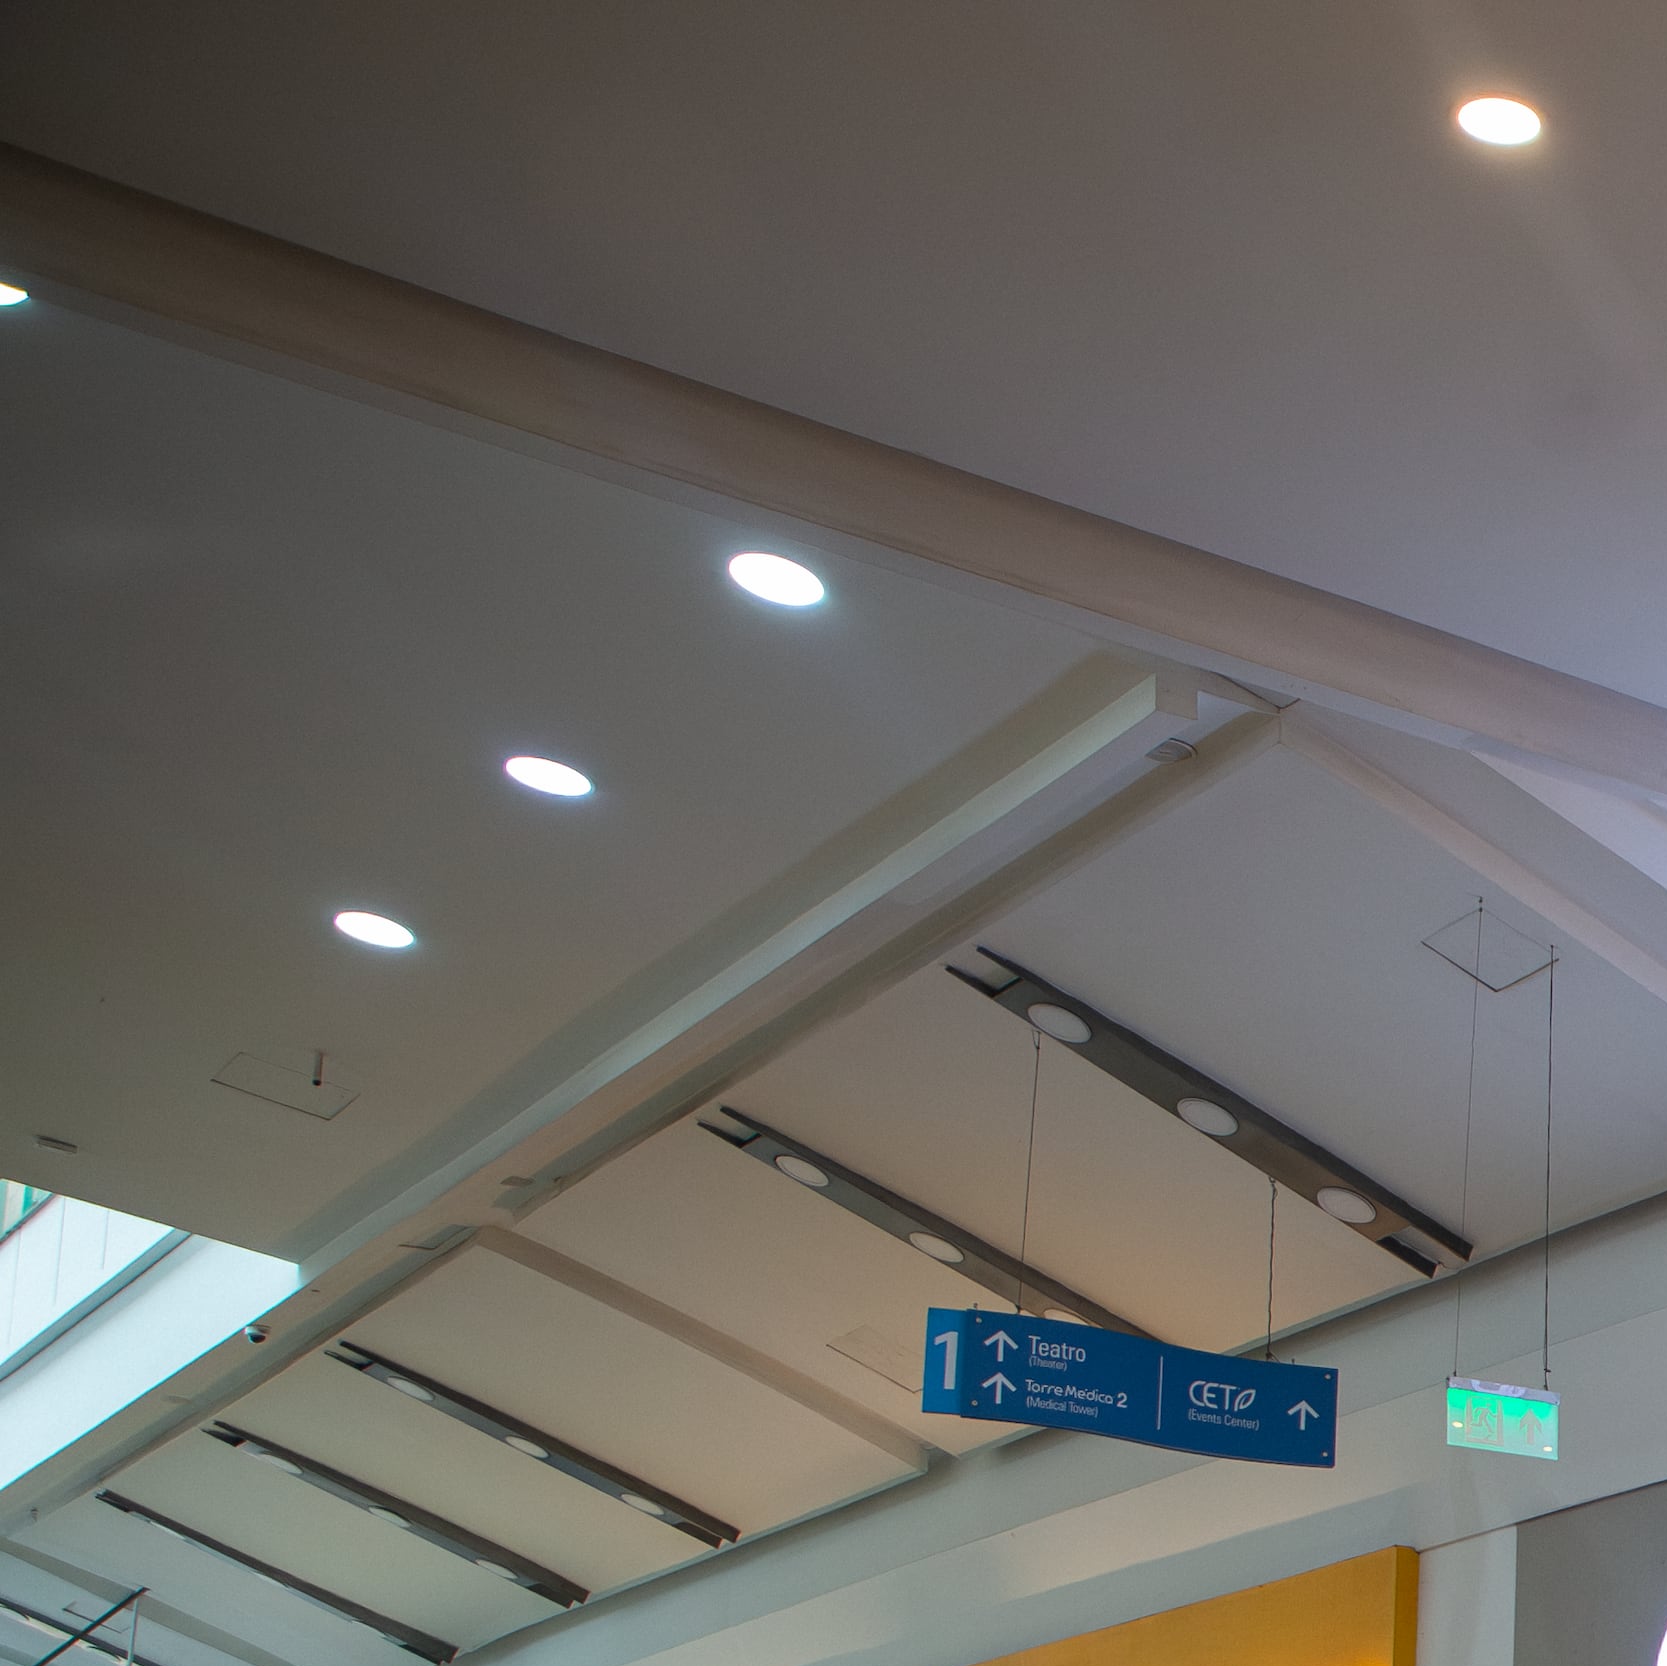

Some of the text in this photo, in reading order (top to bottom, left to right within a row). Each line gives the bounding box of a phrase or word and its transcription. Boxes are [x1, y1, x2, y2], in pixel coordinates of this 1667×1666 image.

[934, 1331, 959, 1390] 1
[1028, 1335, 1086, 1362] Teatro
[1025, 1379, 1064, 1397] Torre
[1116, 1392, 1128, 1408] 2
[1026, 1396, 1098, 1418] (Medical Tower)
[1188, 1408, 1260, 1431] (Events Center)
